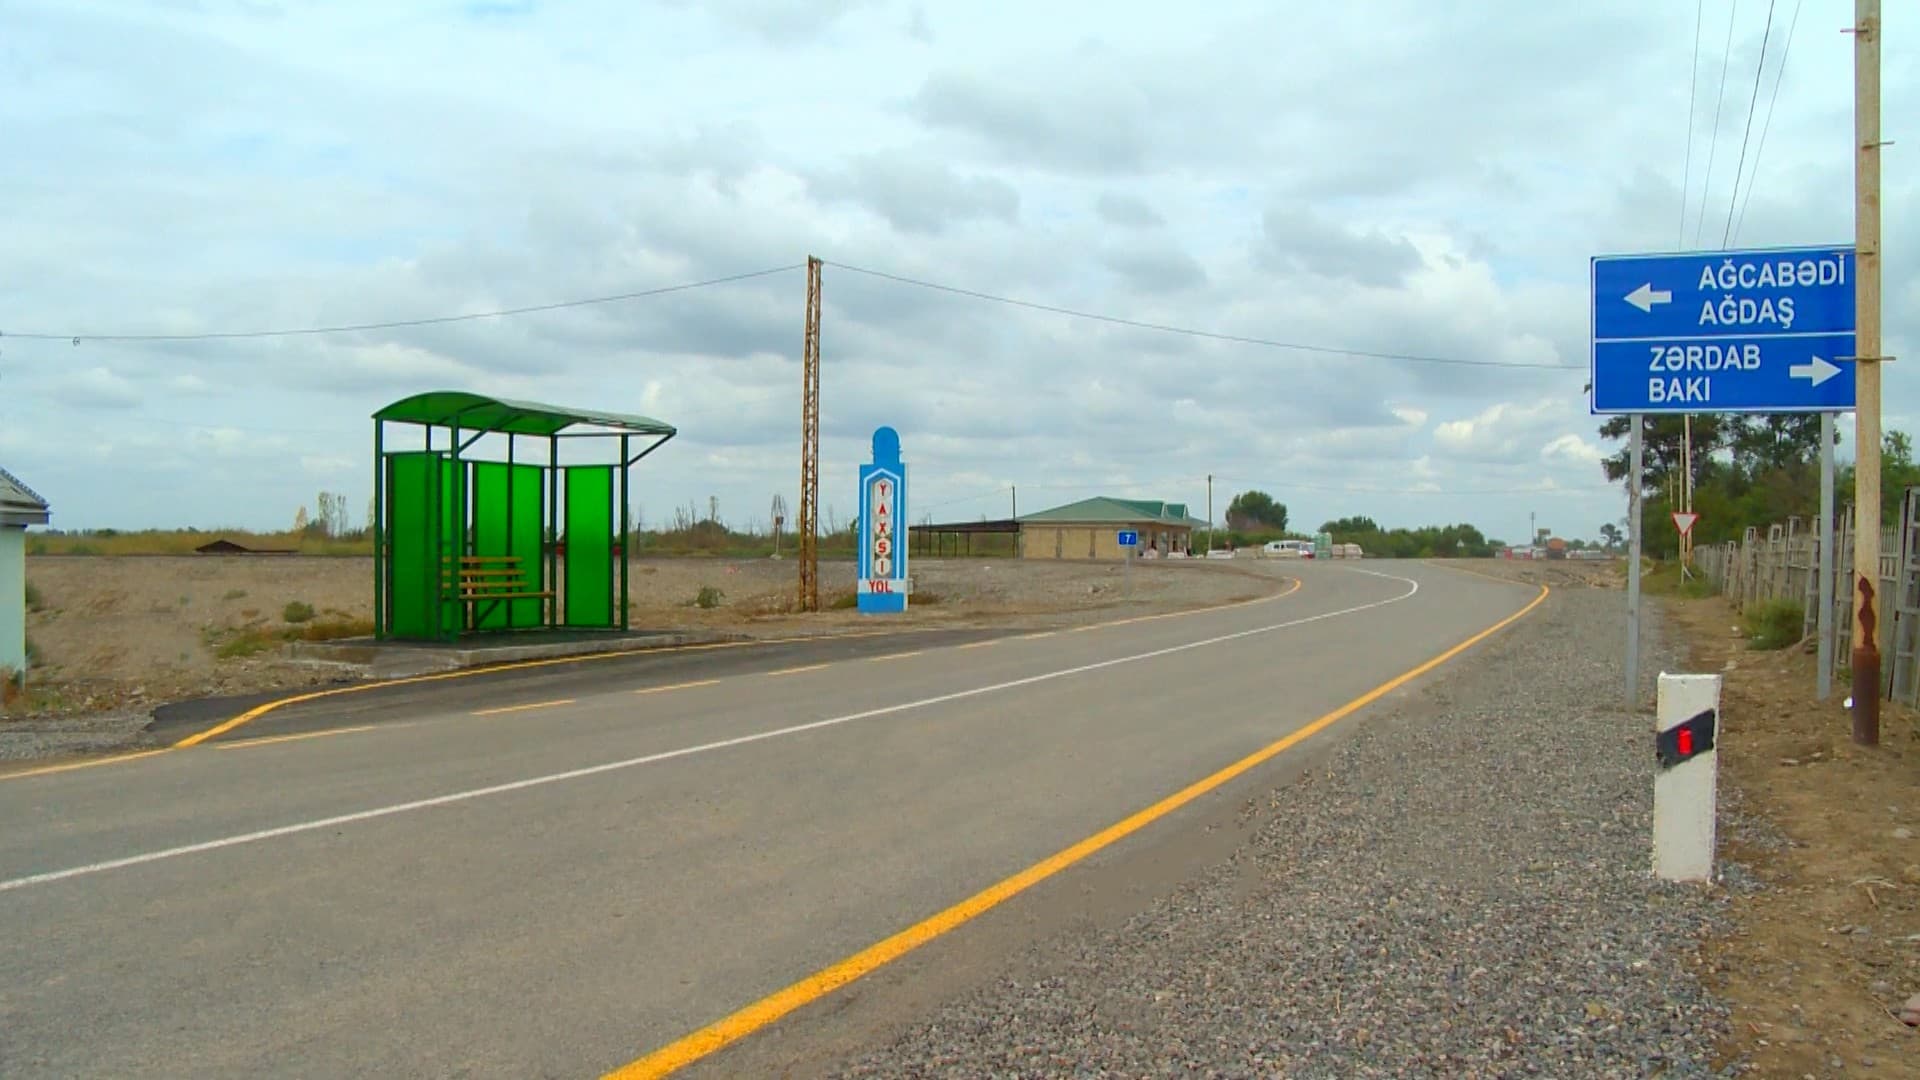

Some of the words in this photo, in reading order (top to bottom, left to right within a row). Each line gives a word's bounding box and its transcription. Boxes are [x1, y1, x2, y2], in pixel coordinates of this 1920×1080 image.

[1698, 254, 1845, 290] AĞCABƏDİ
[1698, 294, 1795, 329] AĞDAŞ
[1649, 344, 1761, 372] ZƏRDAB
[1648, 376, 1711, 402] BAKI
[868, 580, 894, 594] YOL
